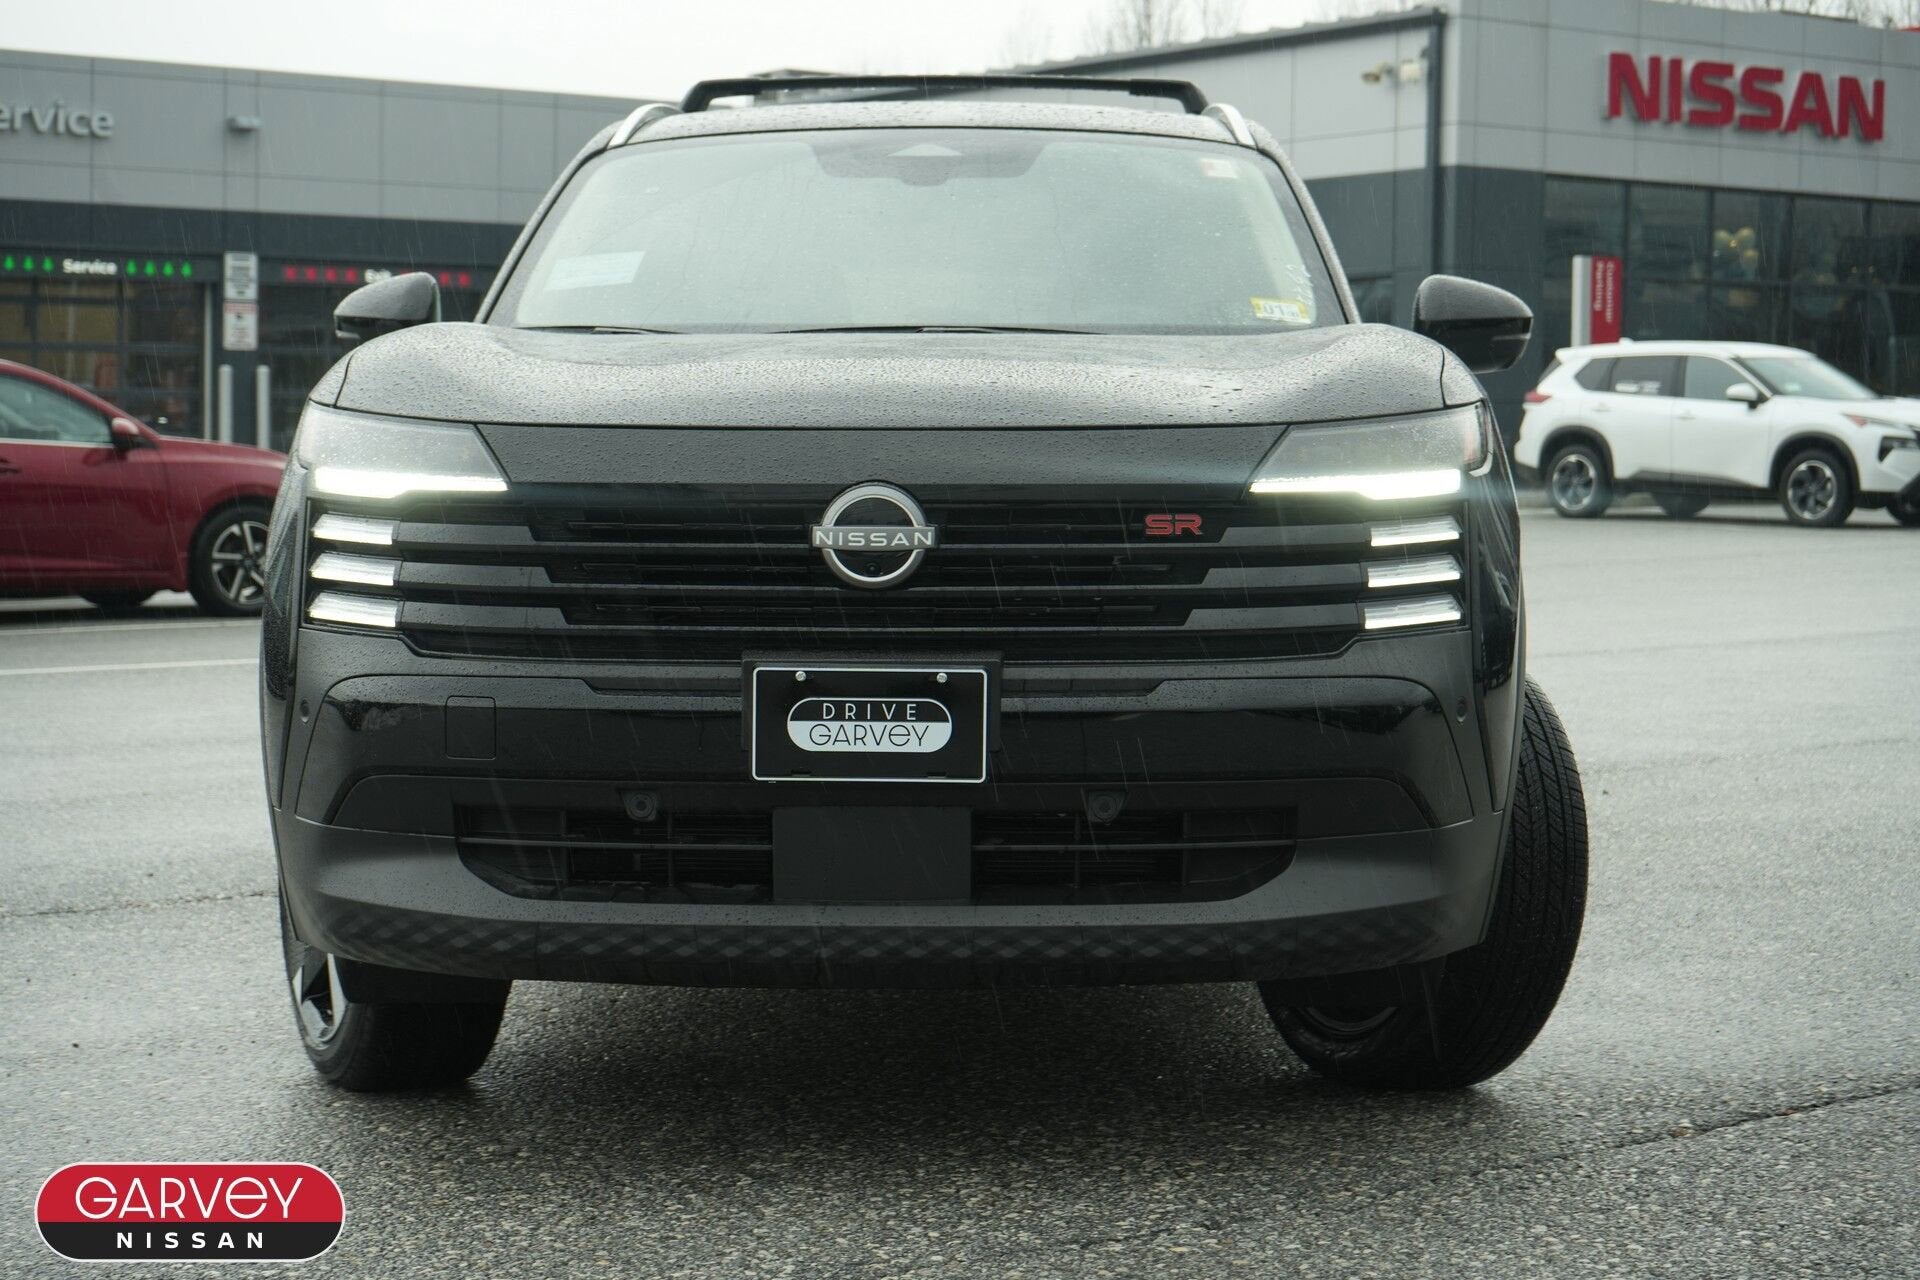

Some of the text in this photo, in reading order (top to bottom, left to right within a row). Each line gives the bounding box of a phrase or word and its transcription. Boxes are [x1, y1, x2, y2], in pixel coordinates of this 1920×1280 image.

[1607, 52, 1885, 140] NISSAN
[63, 258, 118, 275] Service
[1145, 514, 1203, 535] SR
[815, 530, 932, 547] NISSAN
[822, 703, 917, 721] DRIVE
